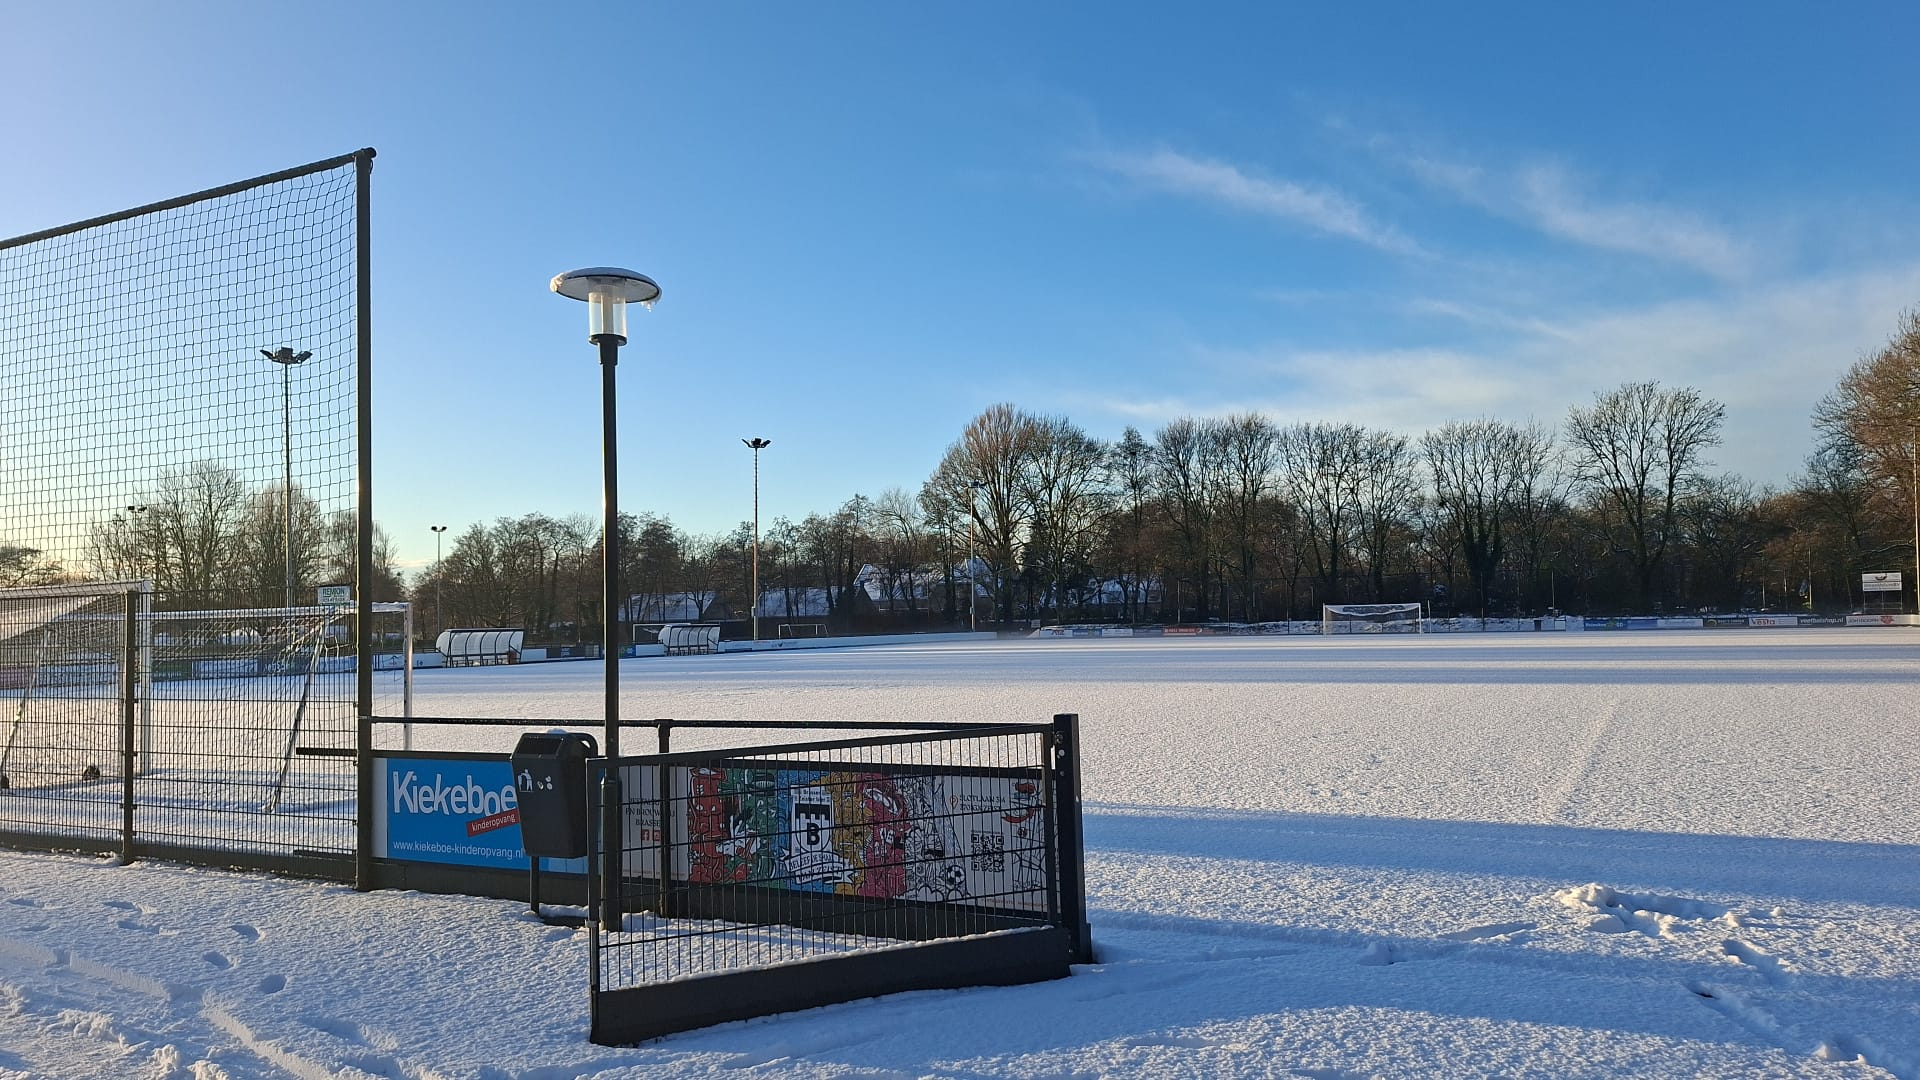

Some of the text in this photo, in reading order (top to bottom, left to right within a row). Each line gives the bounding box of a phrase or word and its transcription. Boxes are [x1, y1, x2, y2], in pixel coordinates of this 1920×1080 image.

[393, 771, 518, 816] Kiekeboe
[471, 813, 516, 832] kinderopvang
[806, 823, 820, 845] B
[393, 840, 524, 860] www.kiekeboe-kinderopvang.nl
